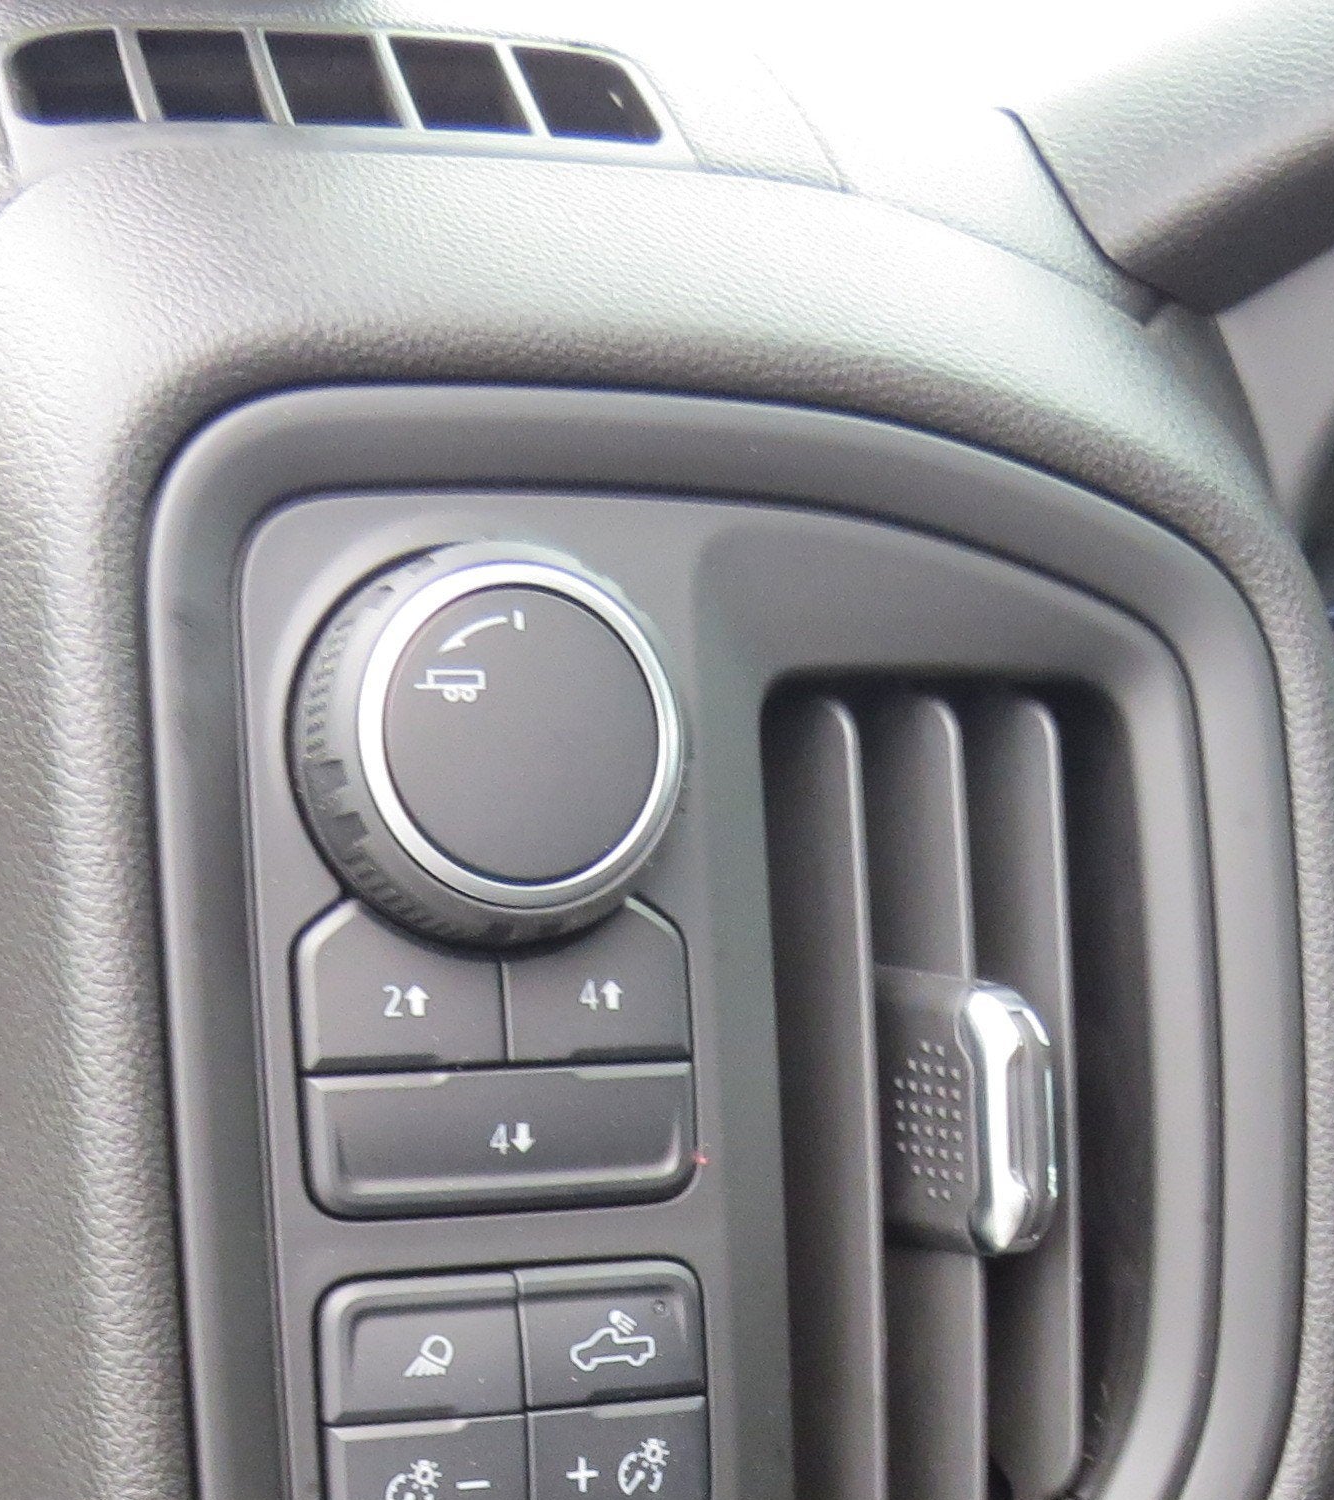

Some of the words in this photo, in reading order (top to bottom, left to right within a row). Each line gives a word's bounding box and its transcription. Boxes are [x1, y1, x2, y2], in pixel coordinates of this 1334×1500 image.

[382, 984, 404, 1018] 2
[579, 979, 599, 1011] 4
[489, 1122, 510, 1156] 4
